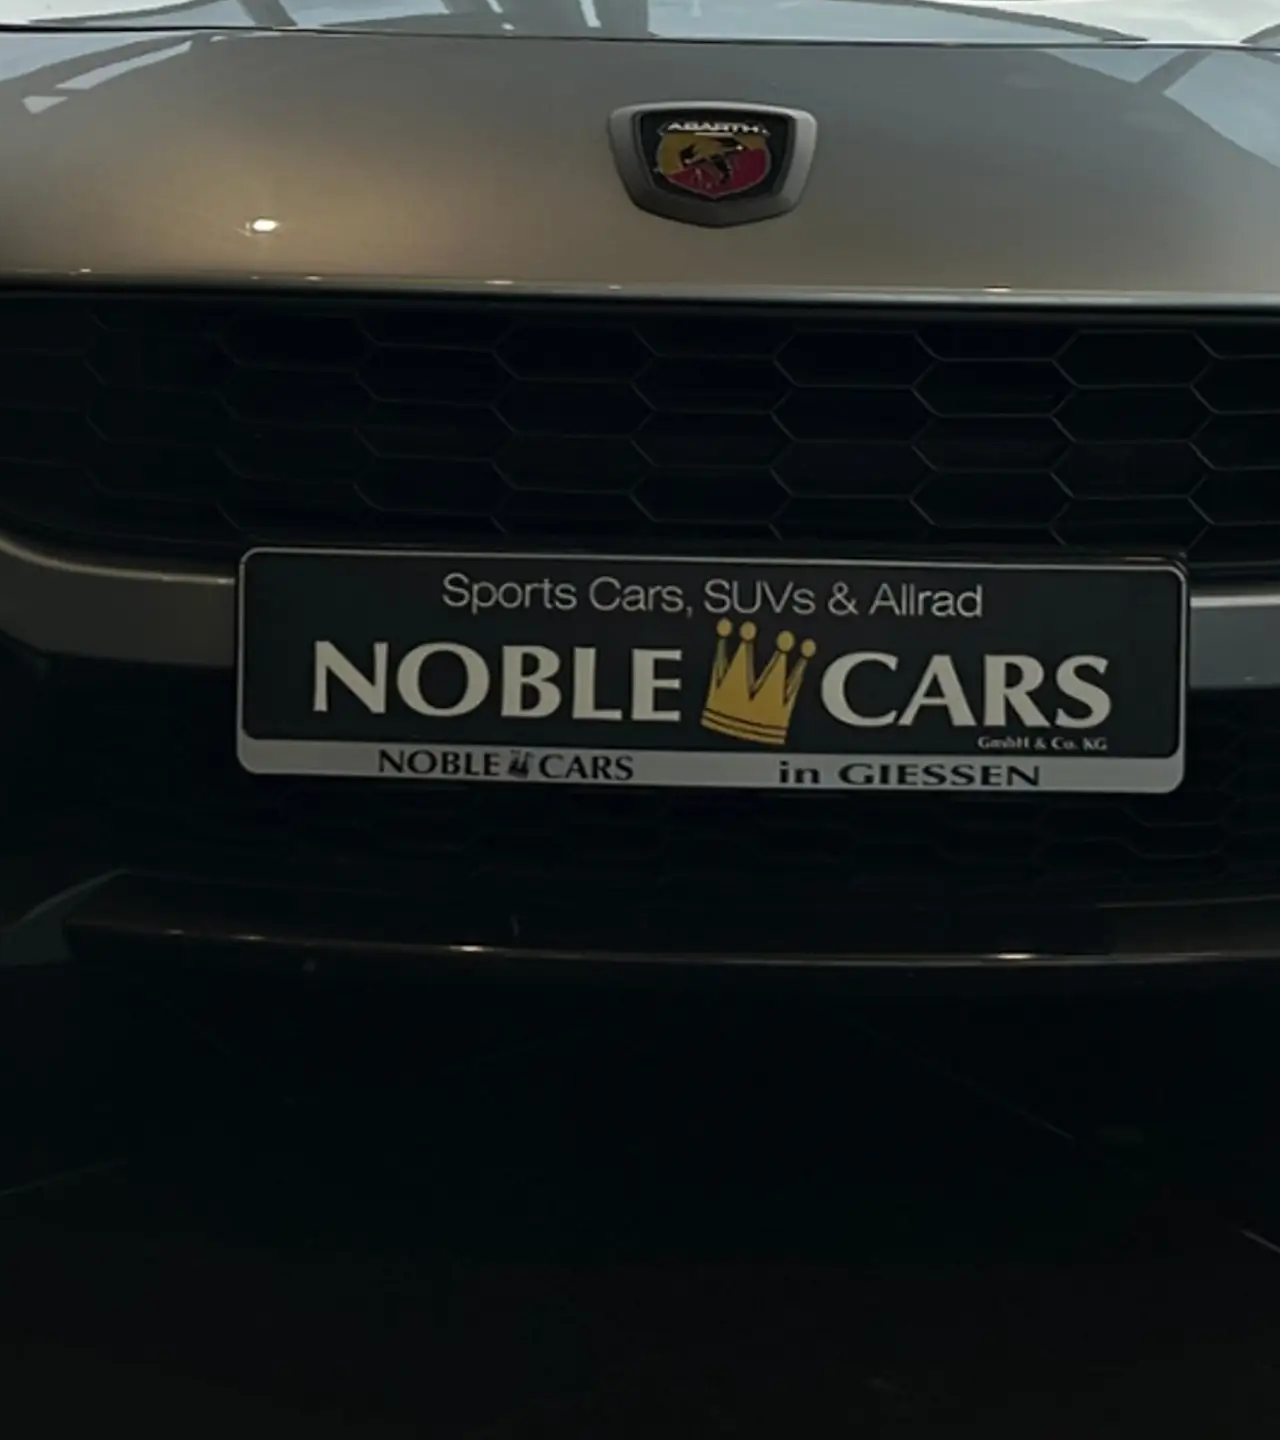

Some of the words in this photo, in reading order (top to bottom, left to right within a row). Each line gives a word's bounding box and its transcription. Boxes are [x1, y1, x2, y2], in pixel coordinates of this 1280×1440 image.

[442, 572, 578, 615] Sports
[588, 575, 694, 618] Cars,
[703, 579, 817, 616] SUVs
[827, 581, 859, 617] &
[868, 583, 984, 618] Allrad
[312, 639, 683, 723] NOBLE
[820, 650, 1112, 730] CARS
[977, 734, 1030, 751] GmbH
[1033, 736, 1049, 751] &
[1051, 735, 1078, 751] Co.
[1082, 736, 1109, 753] KG
[377, 748, 501, 777] NOBLE
[538, 754, 635, 782] CARS
[778, 761, 821, 786] in
[838, 762, 1041, 787] GIESSEN
